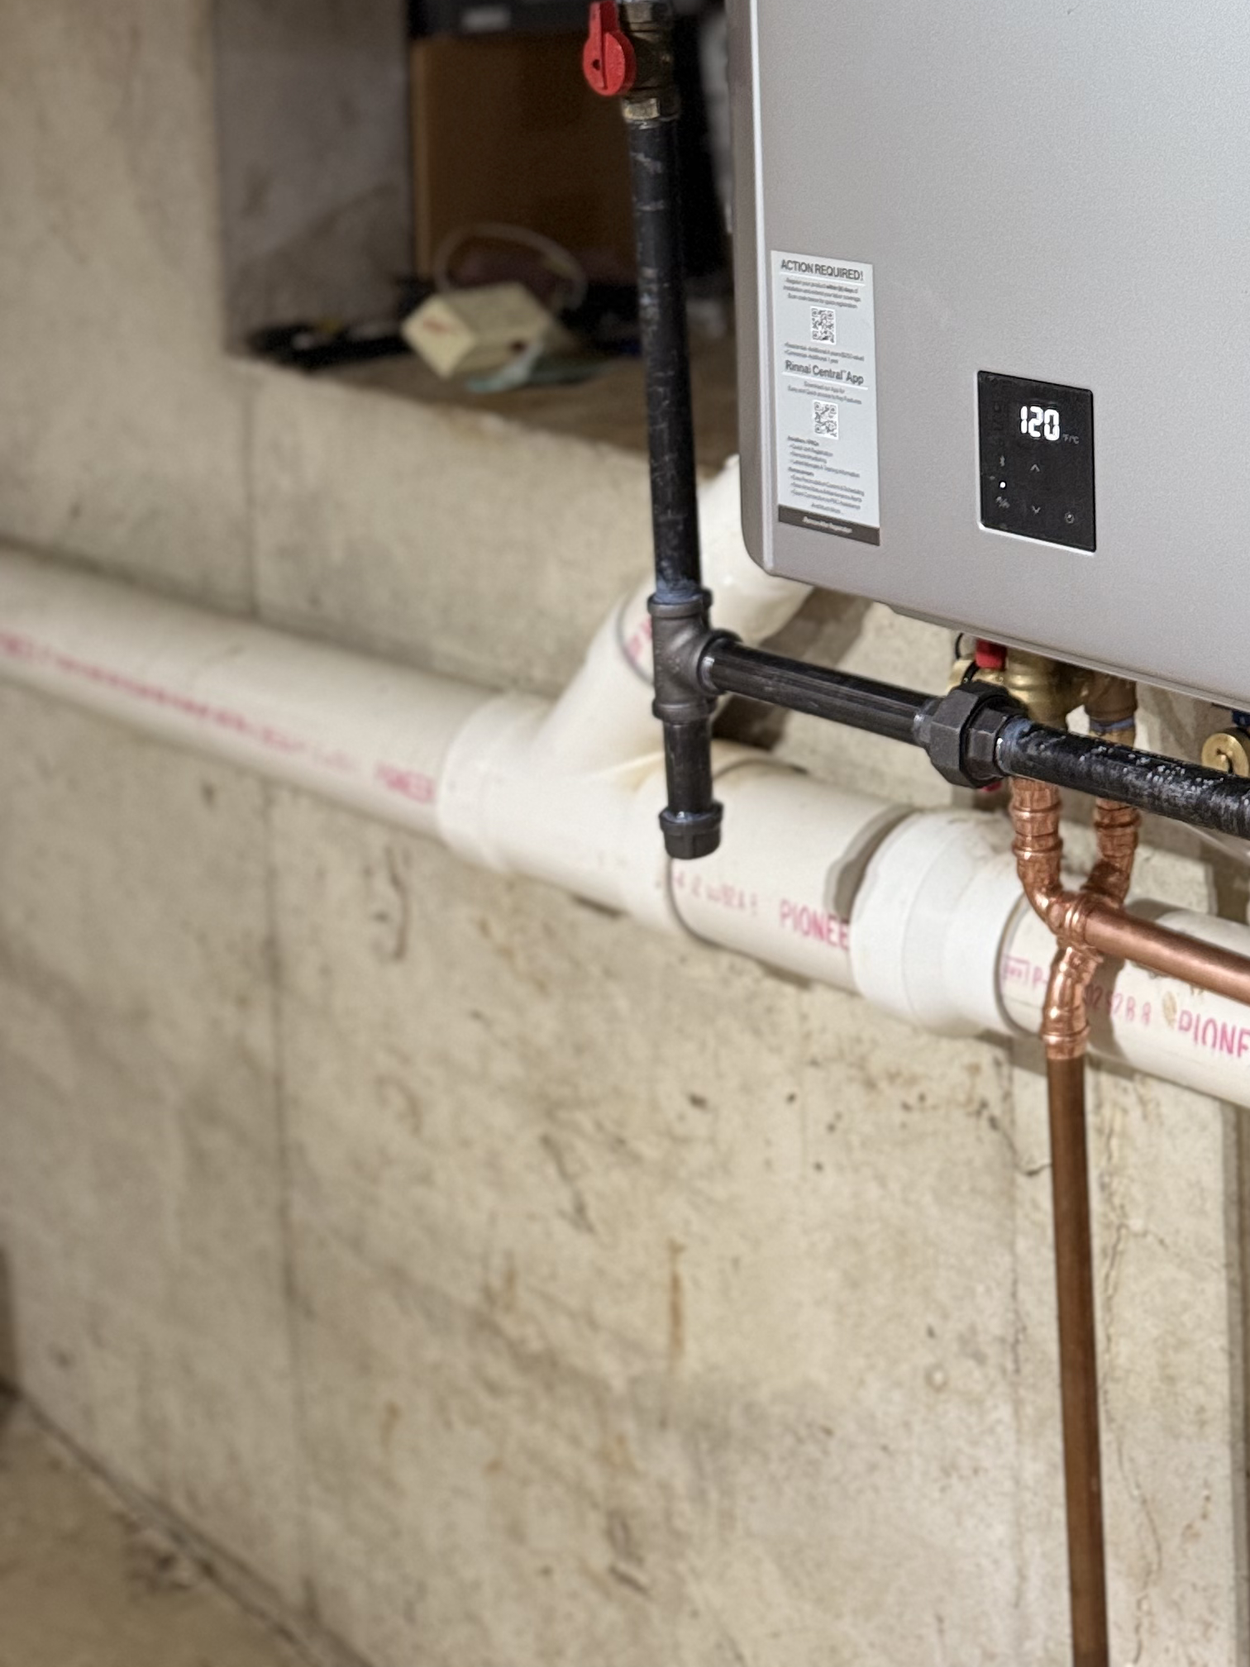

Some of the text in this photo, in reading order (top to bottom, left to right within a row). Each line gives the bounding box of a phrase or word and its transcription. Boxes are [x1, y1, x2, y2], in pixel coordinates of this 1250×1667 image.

[781, 259, 864, 281] ACTION REQUIRED!
[785, 360, 811, 373] Rinnai
[846, 371, 864, 385] App
[1021, 406, 1060, 441] 120
